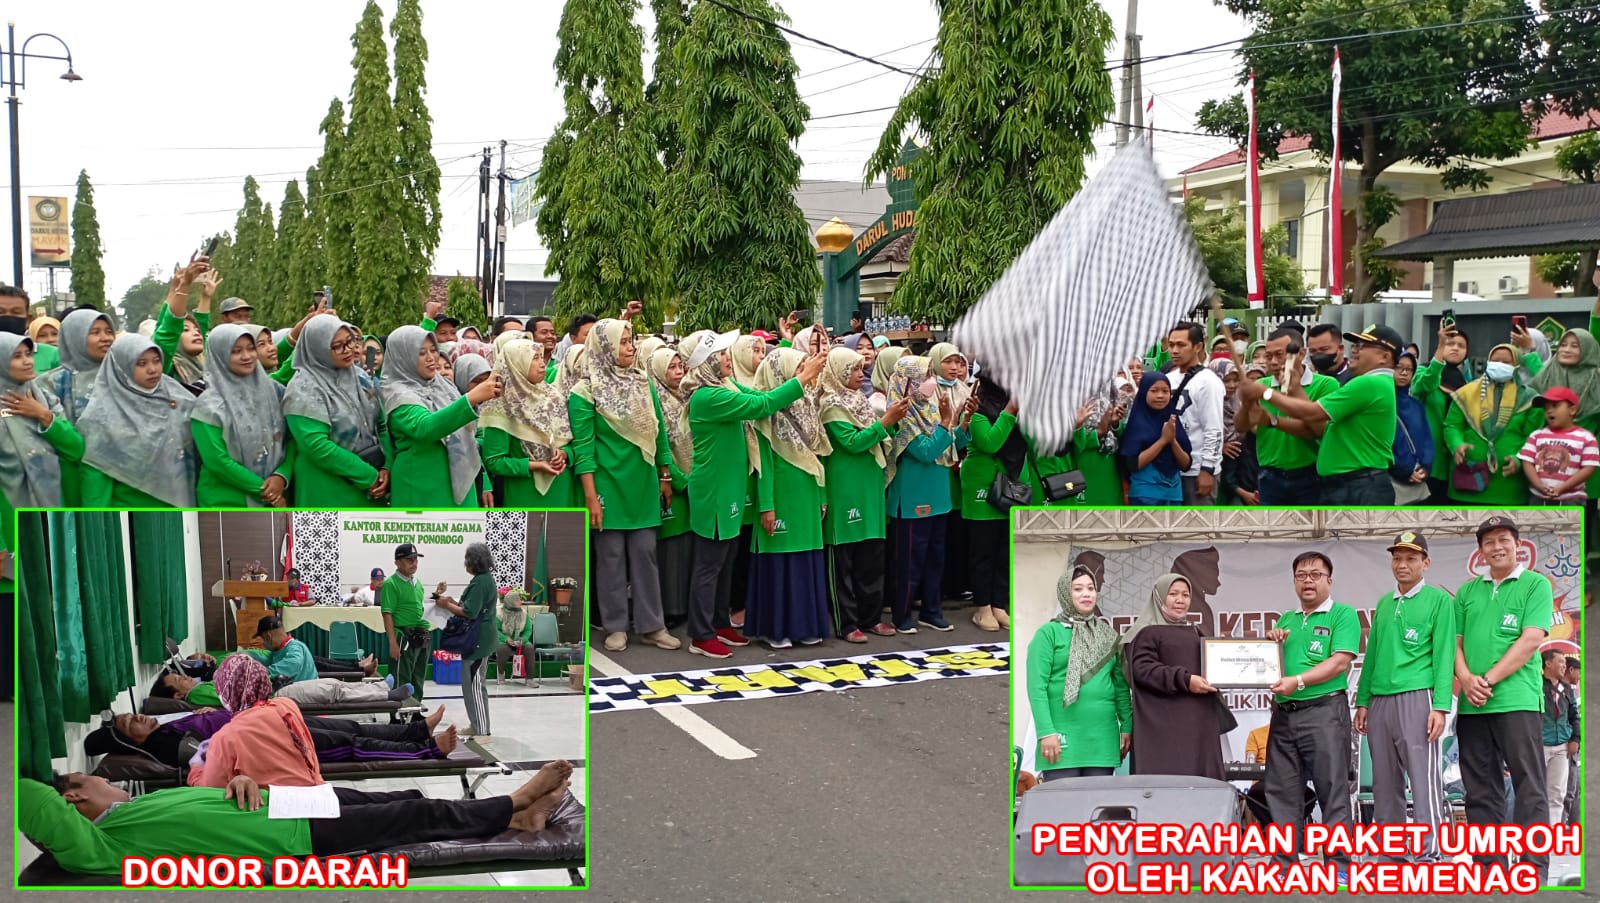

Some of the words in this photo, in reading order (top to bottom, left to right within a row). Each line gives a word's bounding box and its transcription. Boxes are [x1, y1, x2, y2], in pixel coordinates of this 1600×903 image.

[856, 220, 889, 256] DARUL
[343, 520, 382, 532] KANTOR
[383, 521, 449, 533] KEMENTERIAN
[450, 523, 483, 533] AGAMA
[362, 533, 415, 544] KABUPATEN
[417, 534, 464, 544] PONOROGO
[638, 650, 1009, 701] START
